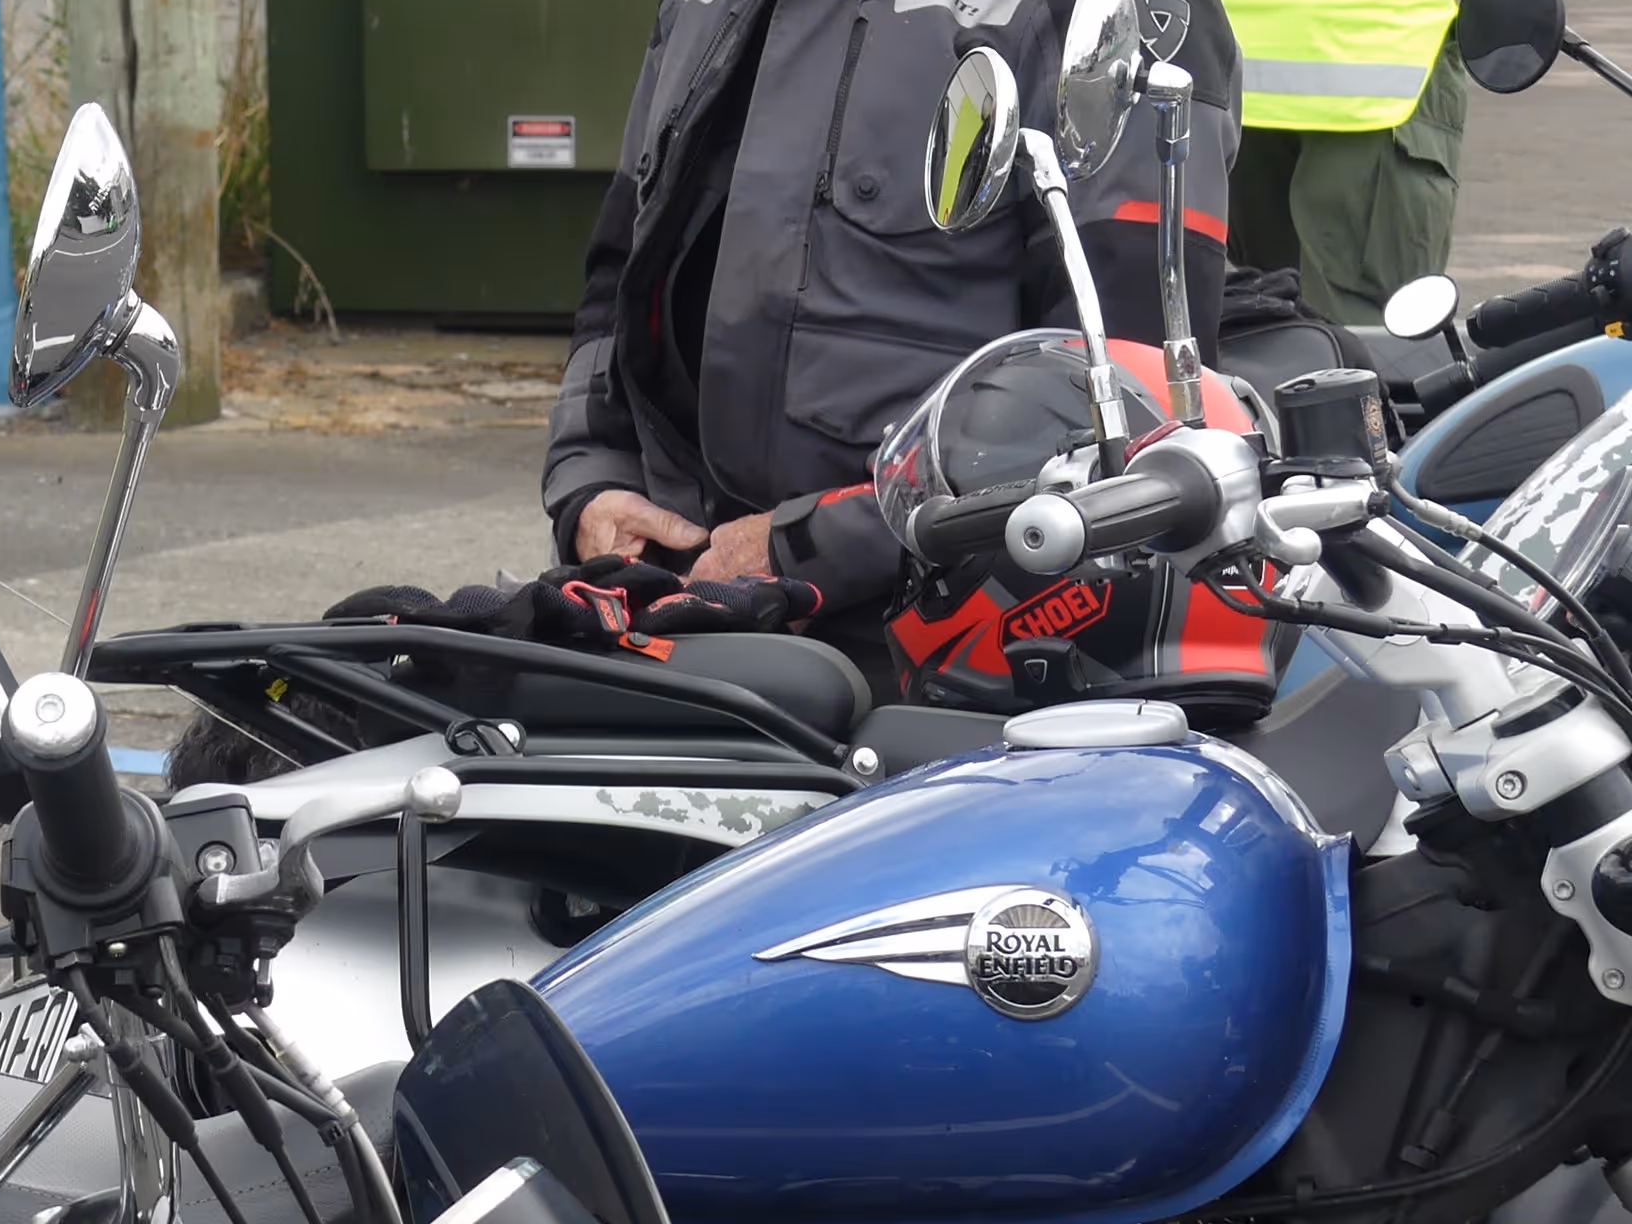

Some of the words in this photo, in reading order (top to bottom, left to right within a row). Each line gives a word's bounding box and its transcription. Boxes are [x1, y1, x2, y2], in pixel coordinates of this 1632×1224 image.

[1009, 584, 1101, 641] SHOEI
[985, 930, 1067, 955] ROYAL
[977, 956, 1079, 979] ENFIELD
